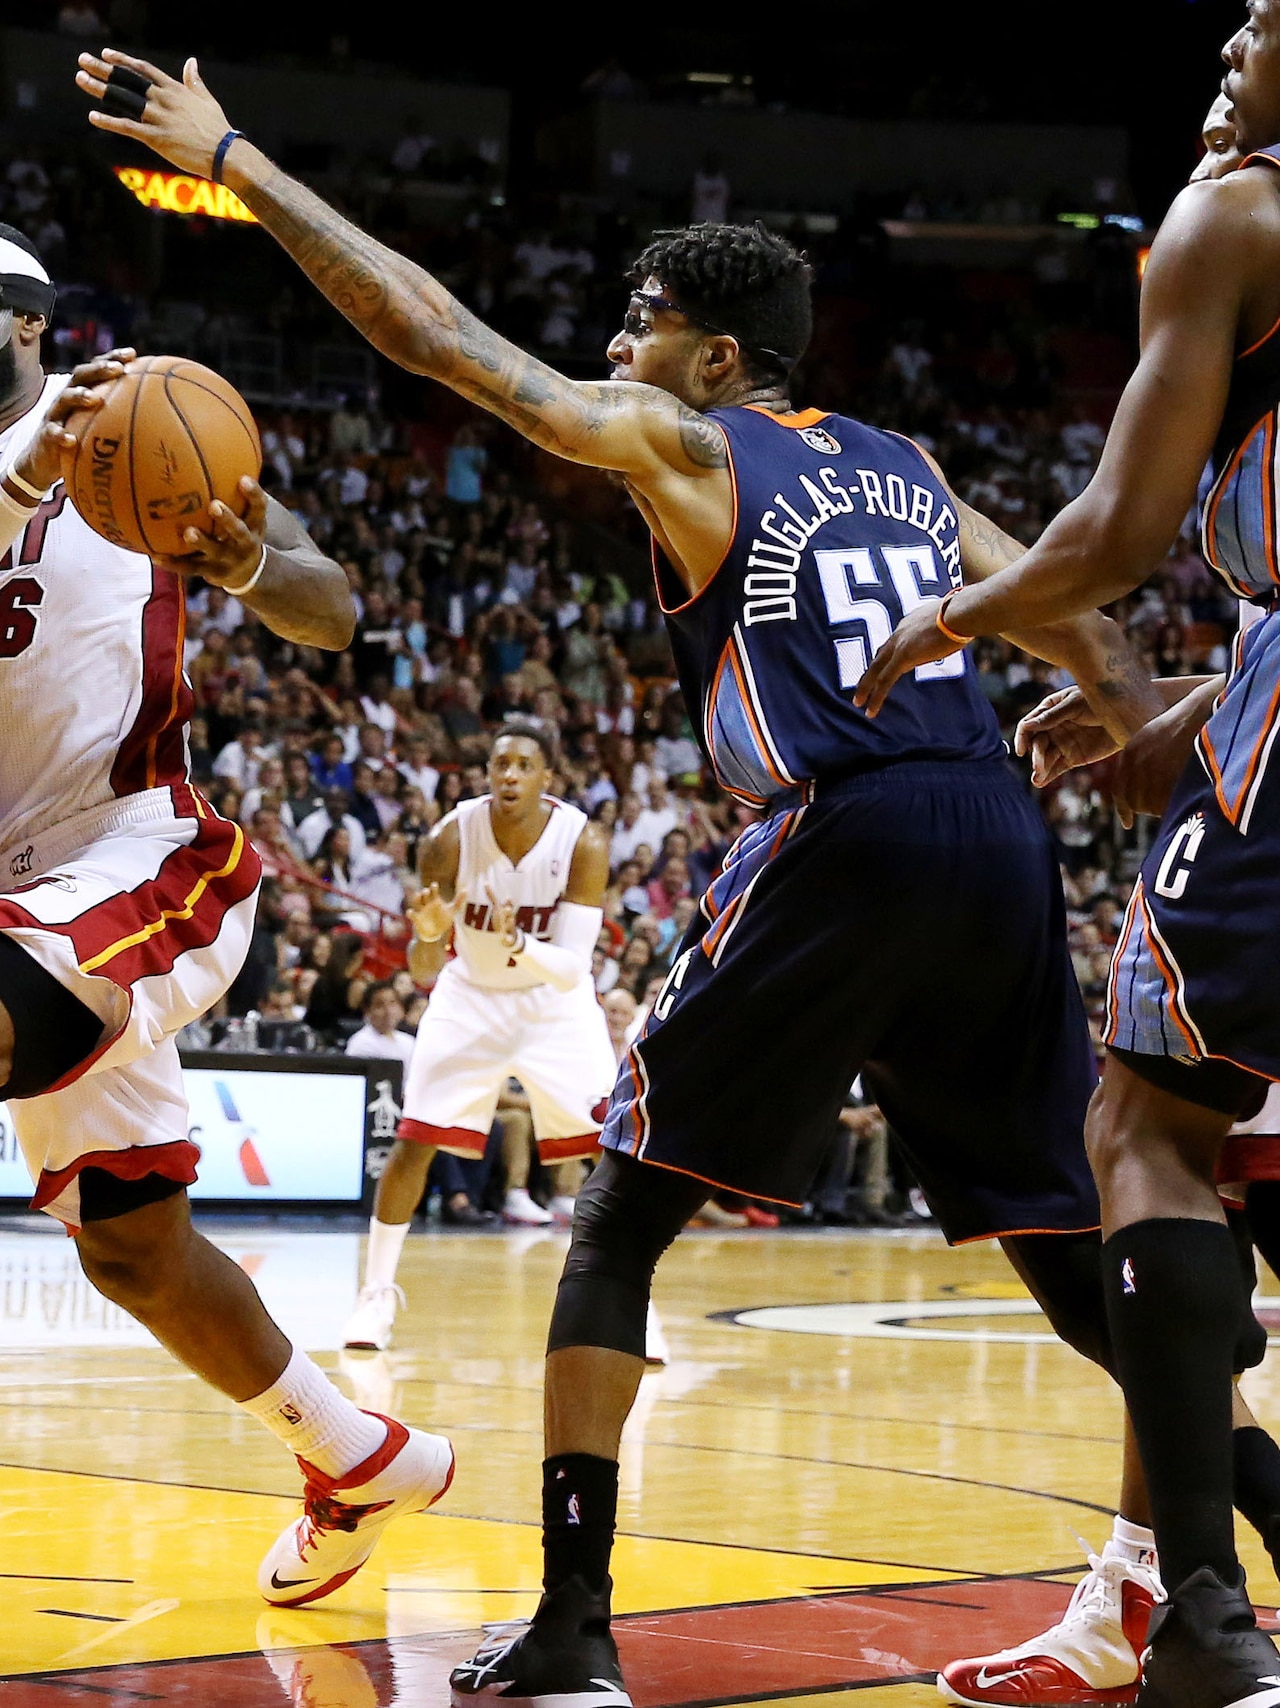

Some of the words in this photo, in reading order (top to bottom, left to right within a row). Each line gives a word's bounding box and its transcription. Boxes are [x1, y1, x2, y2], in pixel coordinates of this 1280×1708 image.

[743, 465, 964, 628] DOUGLAS-ROBERT
[812, 547, 966, 691] 55
[463, 902, 556, 935] HAT
